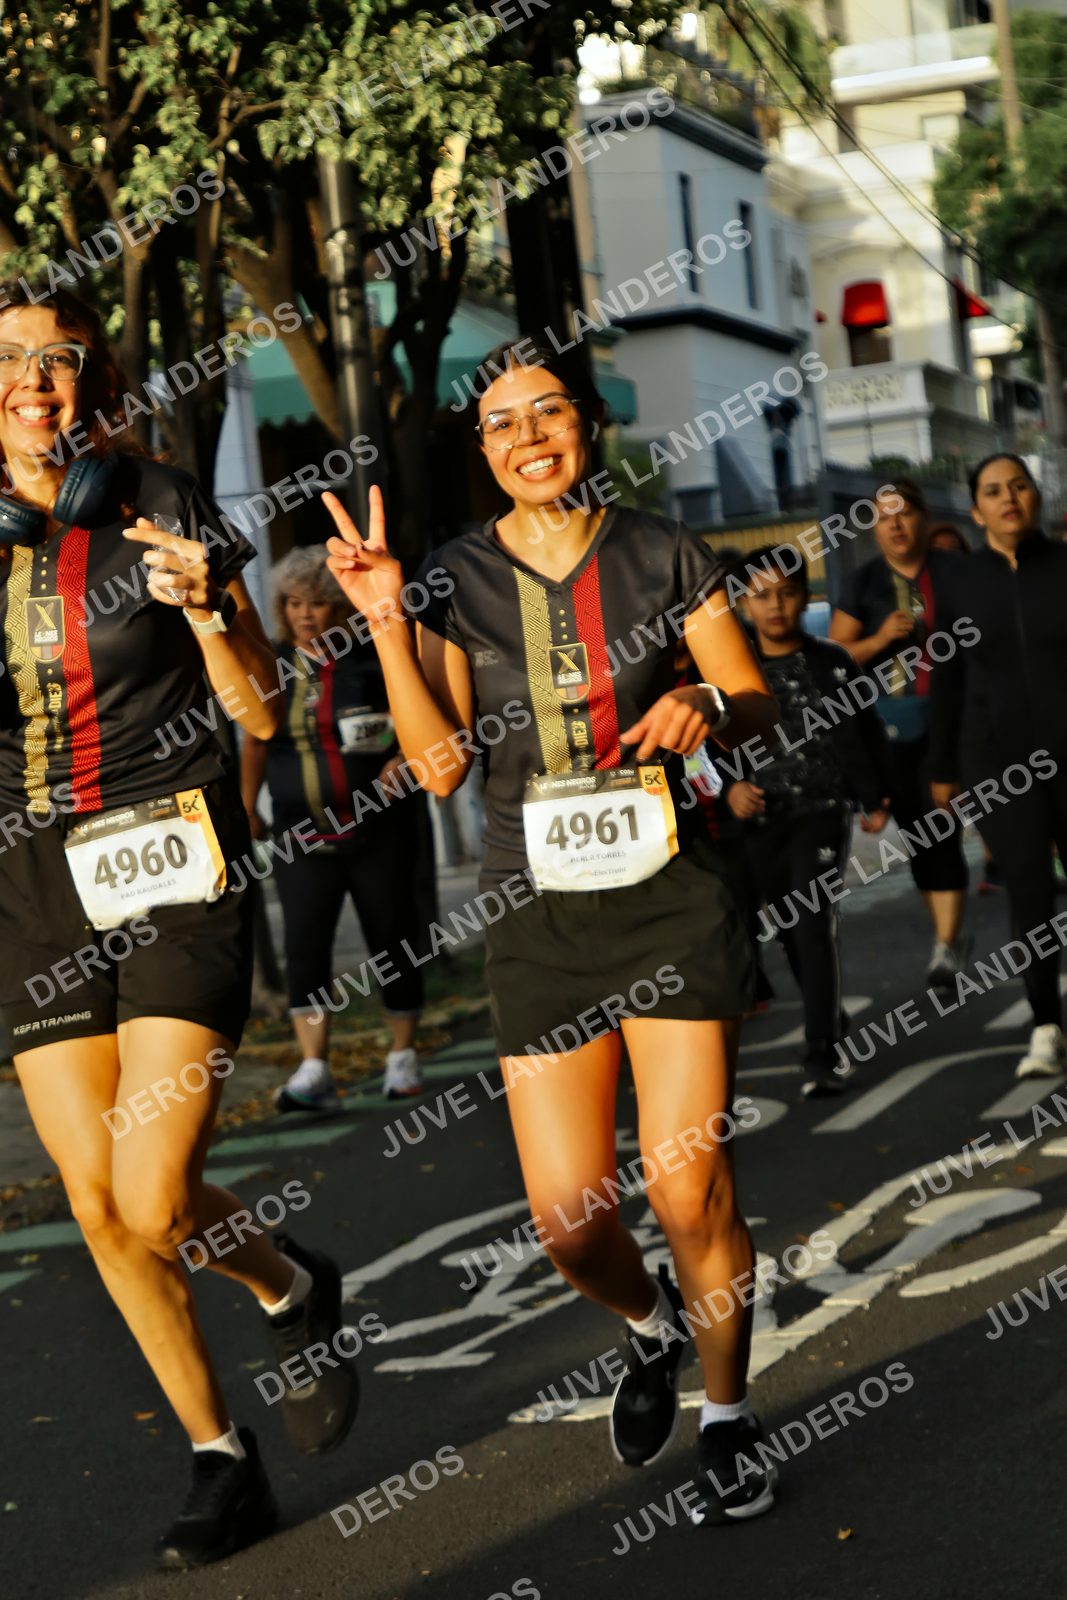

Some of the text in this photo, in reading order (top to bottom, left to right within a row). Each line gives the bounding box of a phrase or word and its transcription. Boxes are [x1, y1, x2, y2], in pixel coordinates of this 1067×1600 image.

[644, 774, 663, 786] 5K
[182, 798, 201, 813] 5K
[545, 804, 640, 851] 4961
[94, 833, 189, 890] 4960
[596, 851, 626, 860] TORRES
